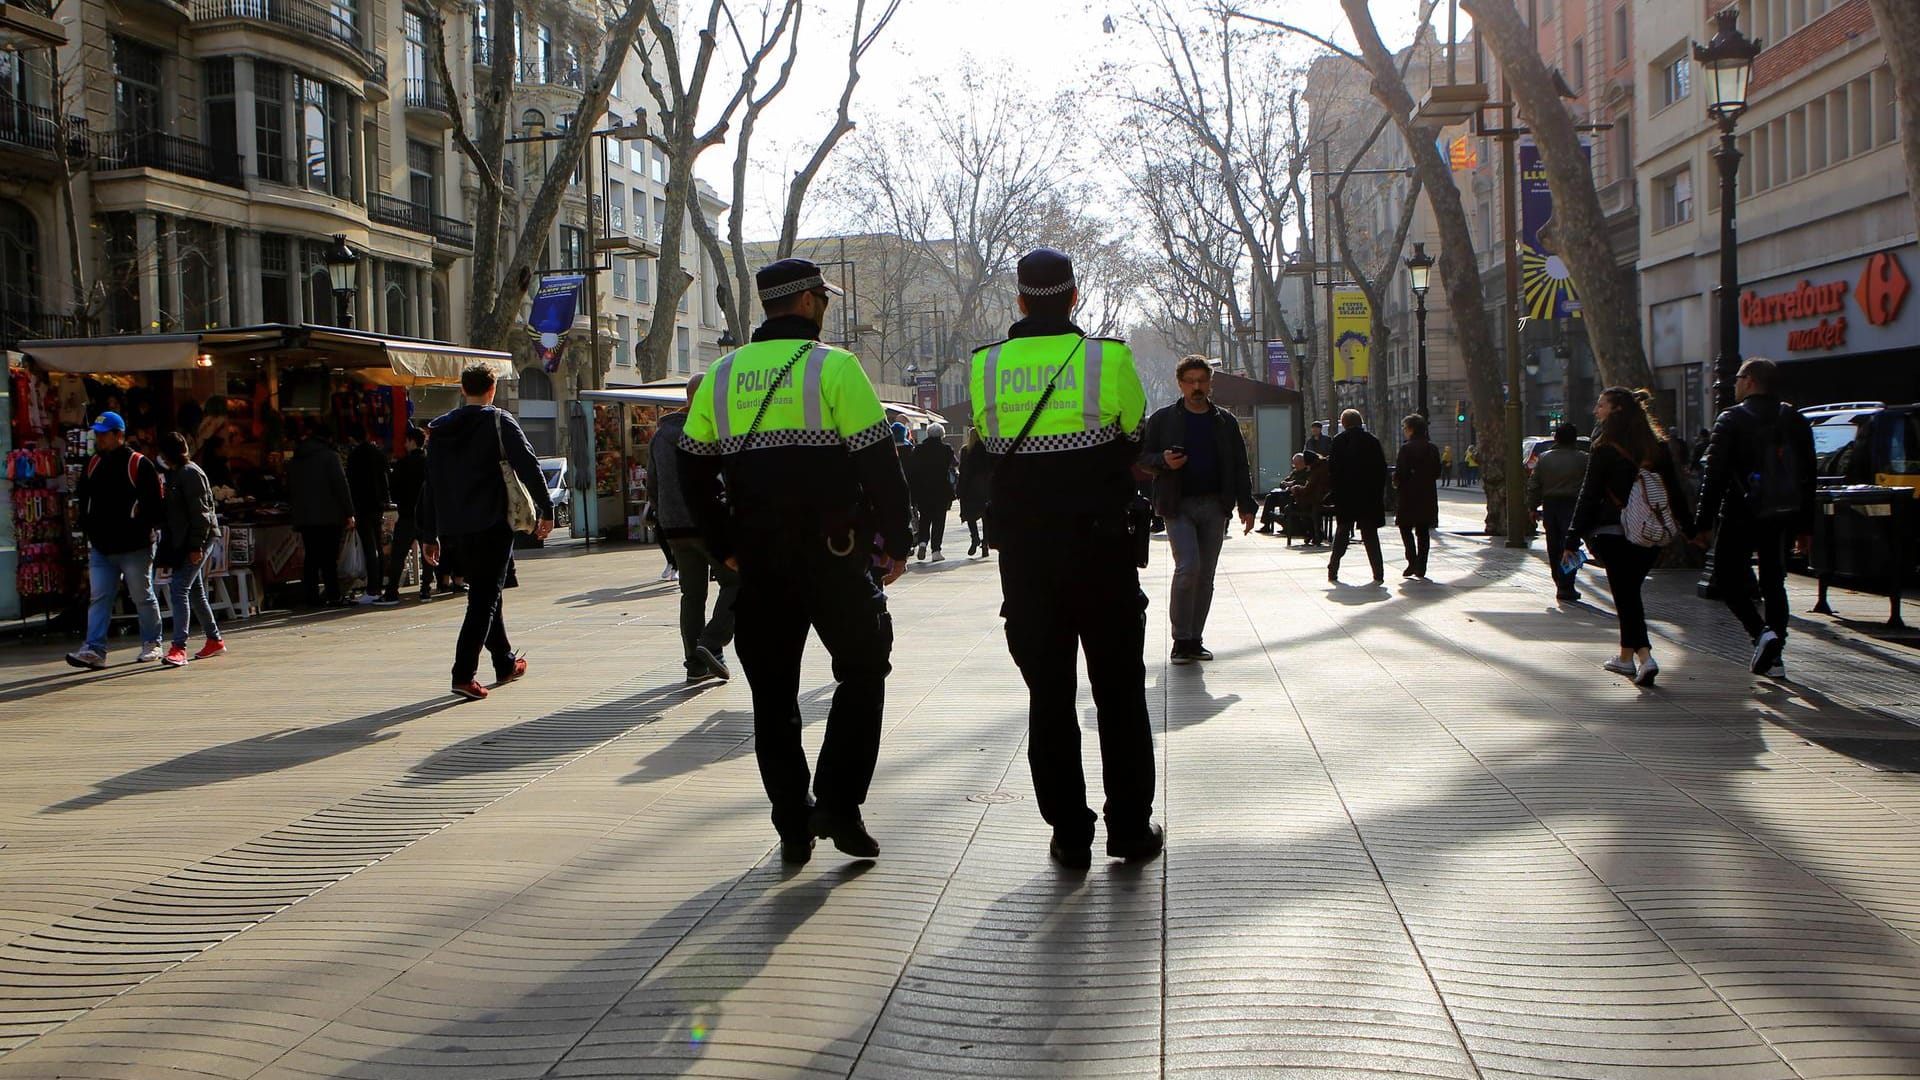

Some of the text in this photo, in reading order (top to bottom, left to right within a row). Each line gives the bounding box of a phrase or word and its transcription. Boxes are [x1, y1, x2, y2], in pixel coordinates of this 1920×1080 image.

[1739, 280, 1847, 326] Carrefour
[1788, 316, 1847, 351] market
[1001, 364, 1076, 394] POLICIA
[737, 397, 763, 410] Guardi
[1001, 399, 1077, 413] Guardi rbana
